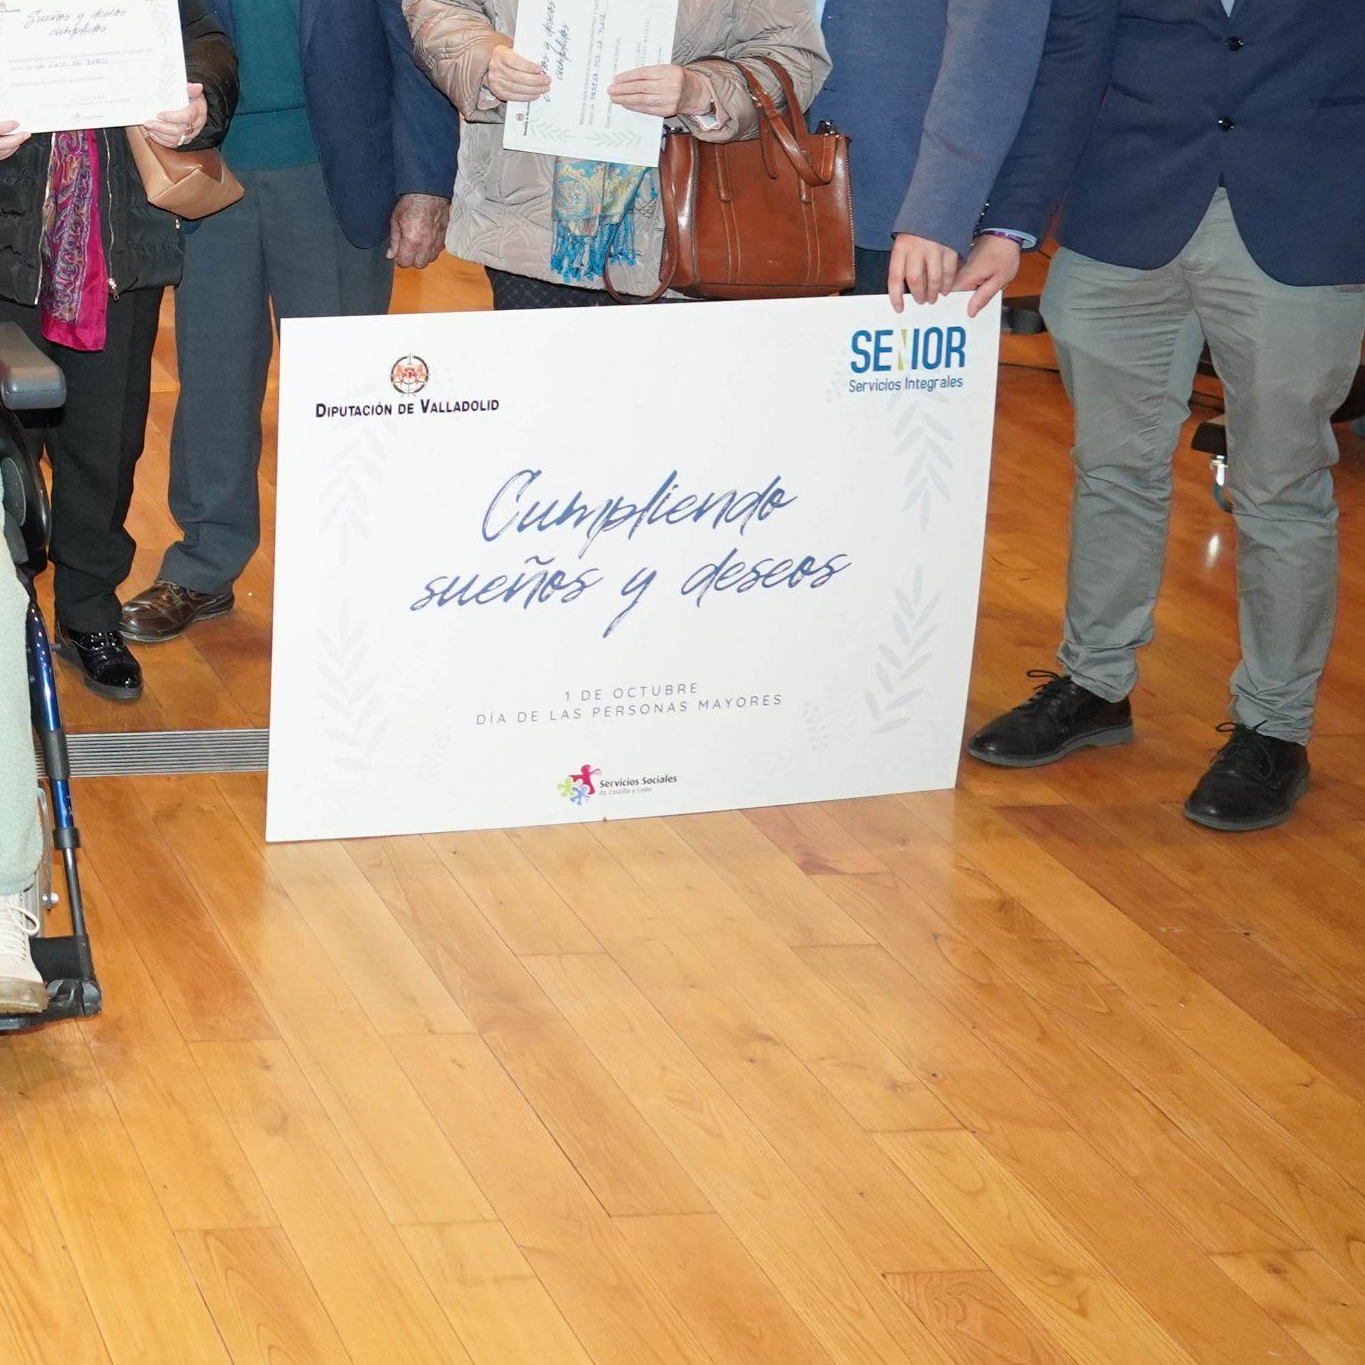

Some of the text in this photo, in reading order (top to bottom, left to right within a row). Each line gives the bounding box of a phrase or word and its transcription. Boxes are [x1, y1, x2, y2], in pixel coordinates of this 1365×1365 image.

[849, 376, 963, 392] Servicios Integrales
[315, 399, 500, 418] DIPUTACIÓN DE VALLADOLID
[482, 468, 798, 560] Cumpliendo
[410, 547, 852, 639] sueños y deseos
[565, 682, 699, 702] 1 DE OCTUBRE
[476, 694, 783, 726] DÍA DE LAS PERSONAS MAYORES
[600, 775, 677, 788] Servicios Sociales
